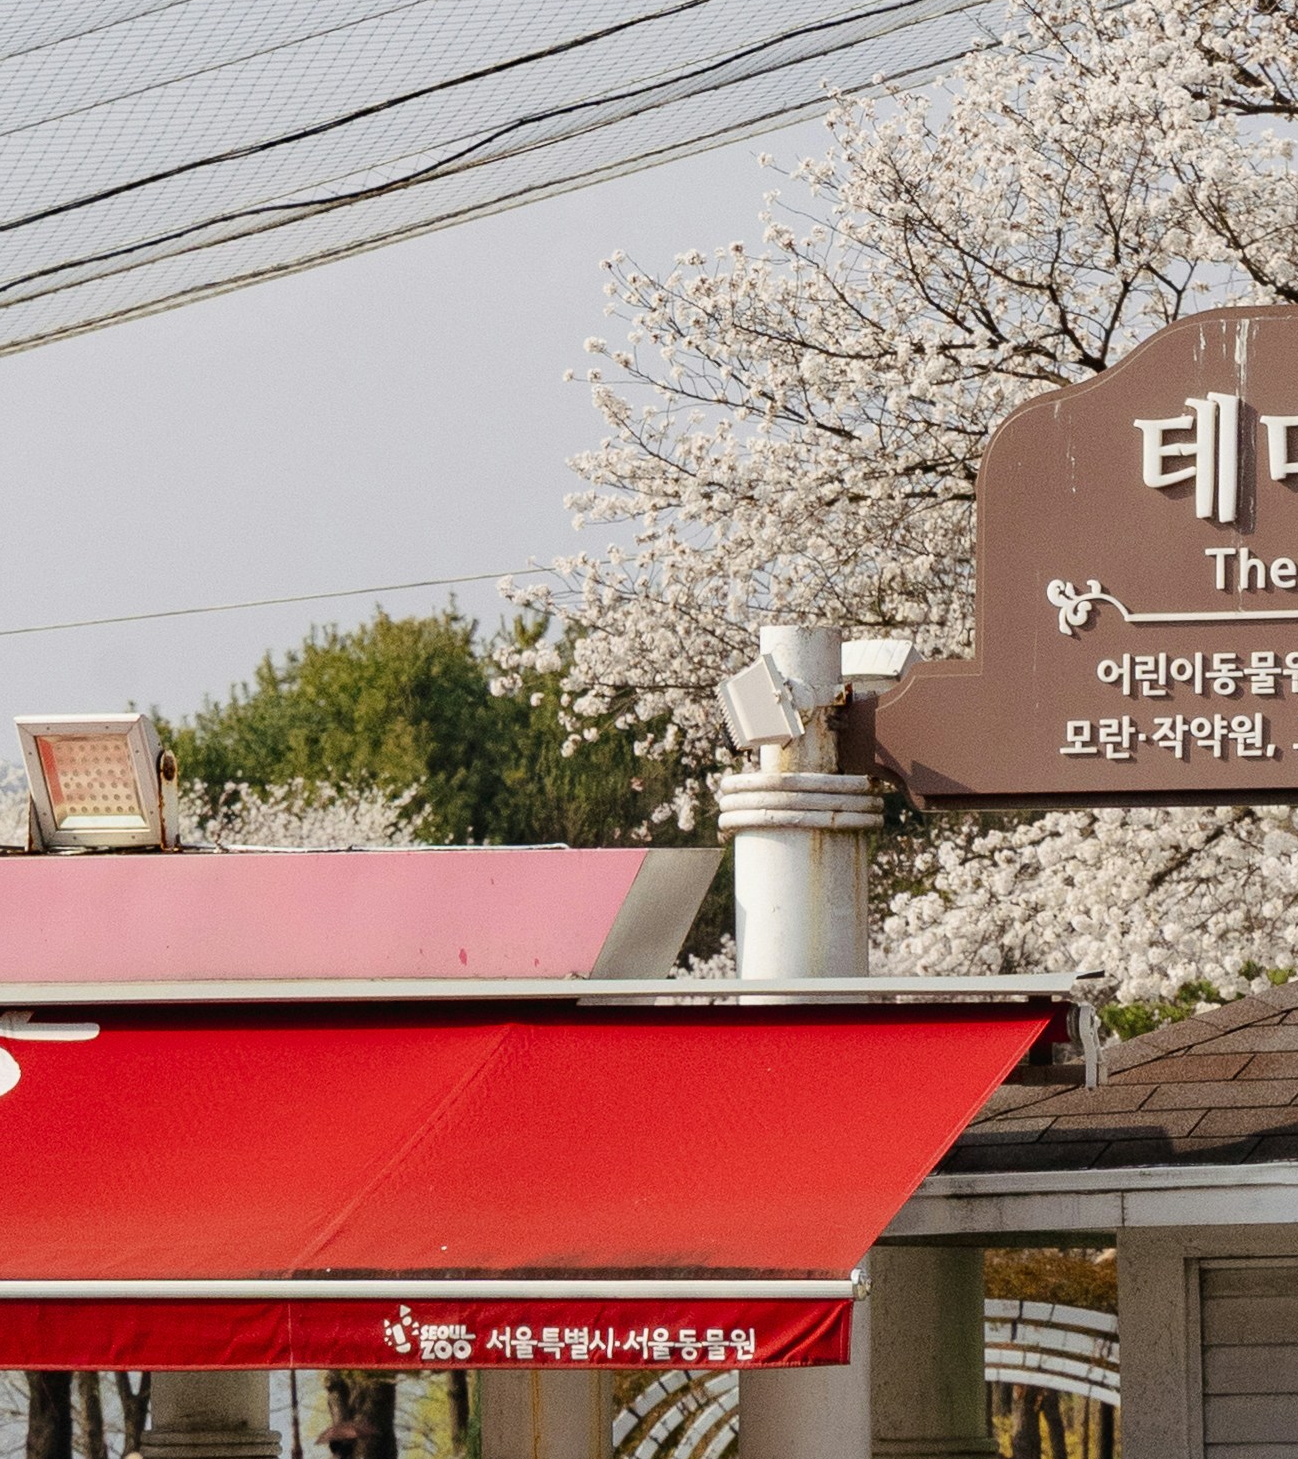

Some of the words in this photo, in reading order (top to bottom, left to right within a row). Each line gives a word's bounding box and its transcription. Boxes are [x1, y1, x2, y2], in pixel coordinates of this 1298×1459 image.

[1059, 712, 1276, 760] 모란·작약원,
[420, 1324, 476, 1340] SEOUL
[486, 1326, 756, 1361] 서울특별시·서울동물원
[420, 1339, 472, 1360] ZOO
